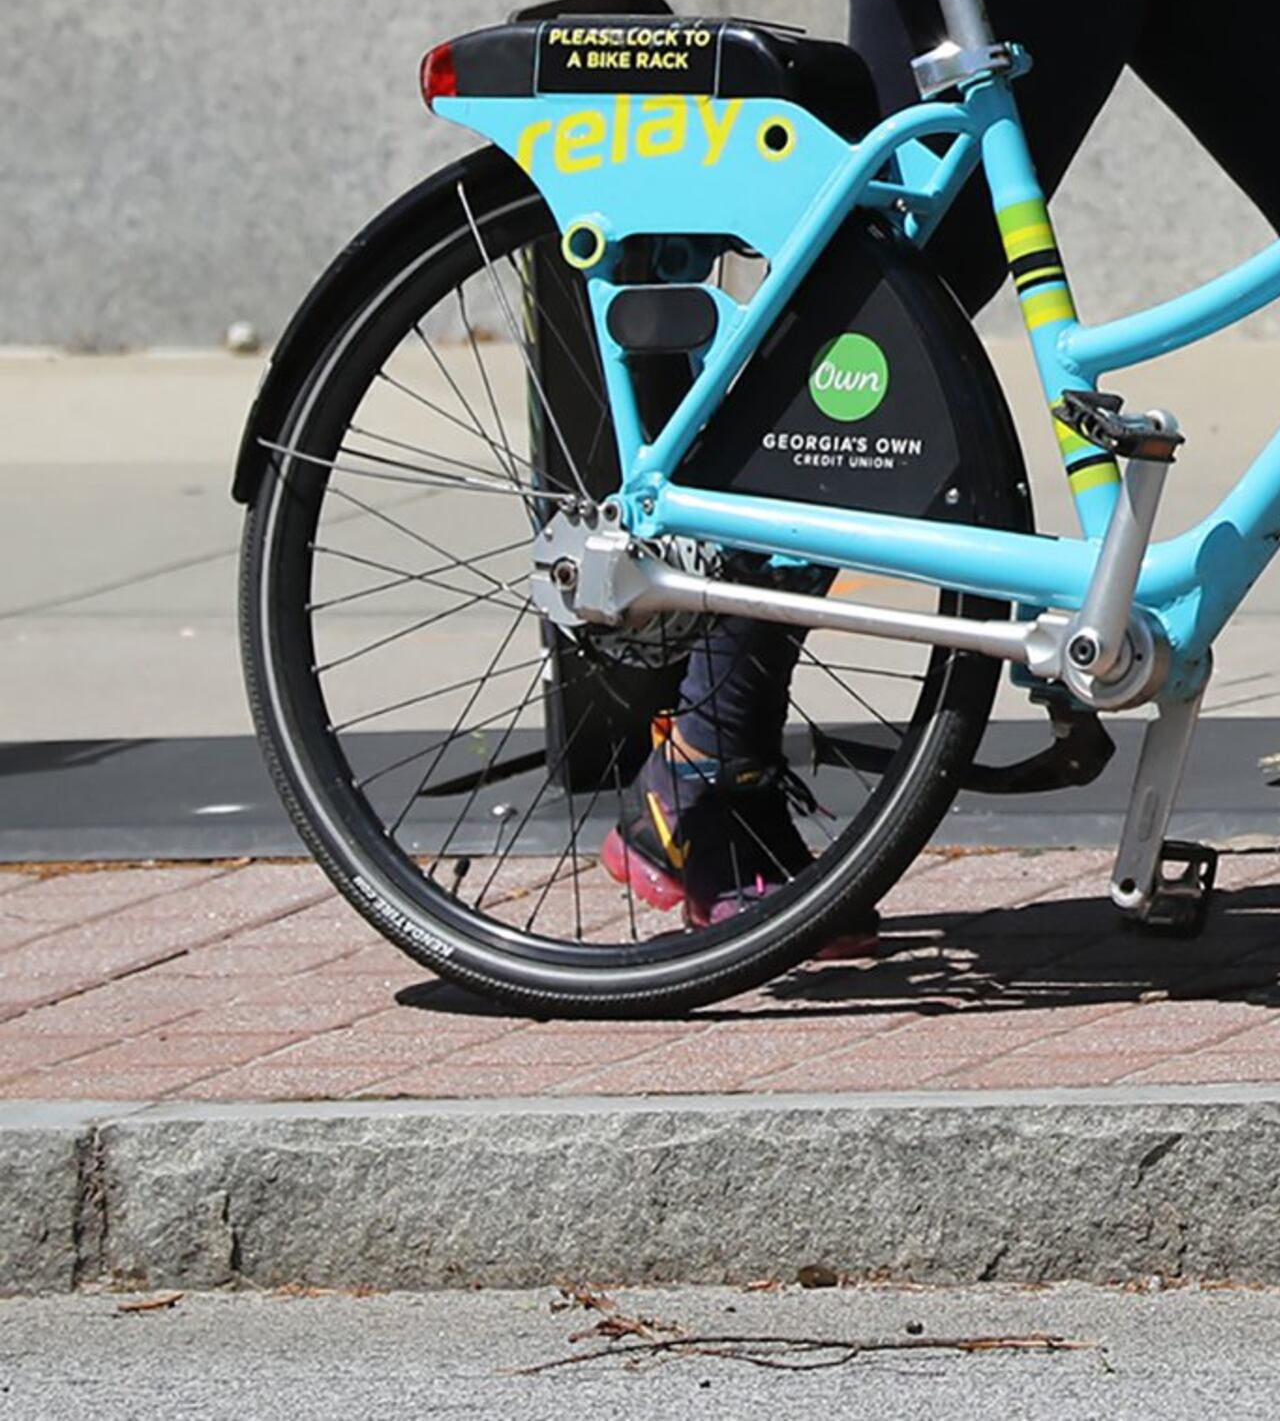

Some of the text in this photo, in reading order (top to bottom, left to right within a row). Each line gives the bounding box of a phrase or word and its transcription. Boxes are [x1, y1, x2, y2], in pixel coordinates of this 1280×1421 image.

[549, 28, 711, 46] PLEASE LOCK TO
[566, 51, 689, 69] A BIKE RACK
[516, 94, 743, 175] relay
[814, 360, 880, 392] Own
[762, 433, 923, 455] GEORGIA'S OWN
[793, 453, 894, 469] CREDIT UNION
